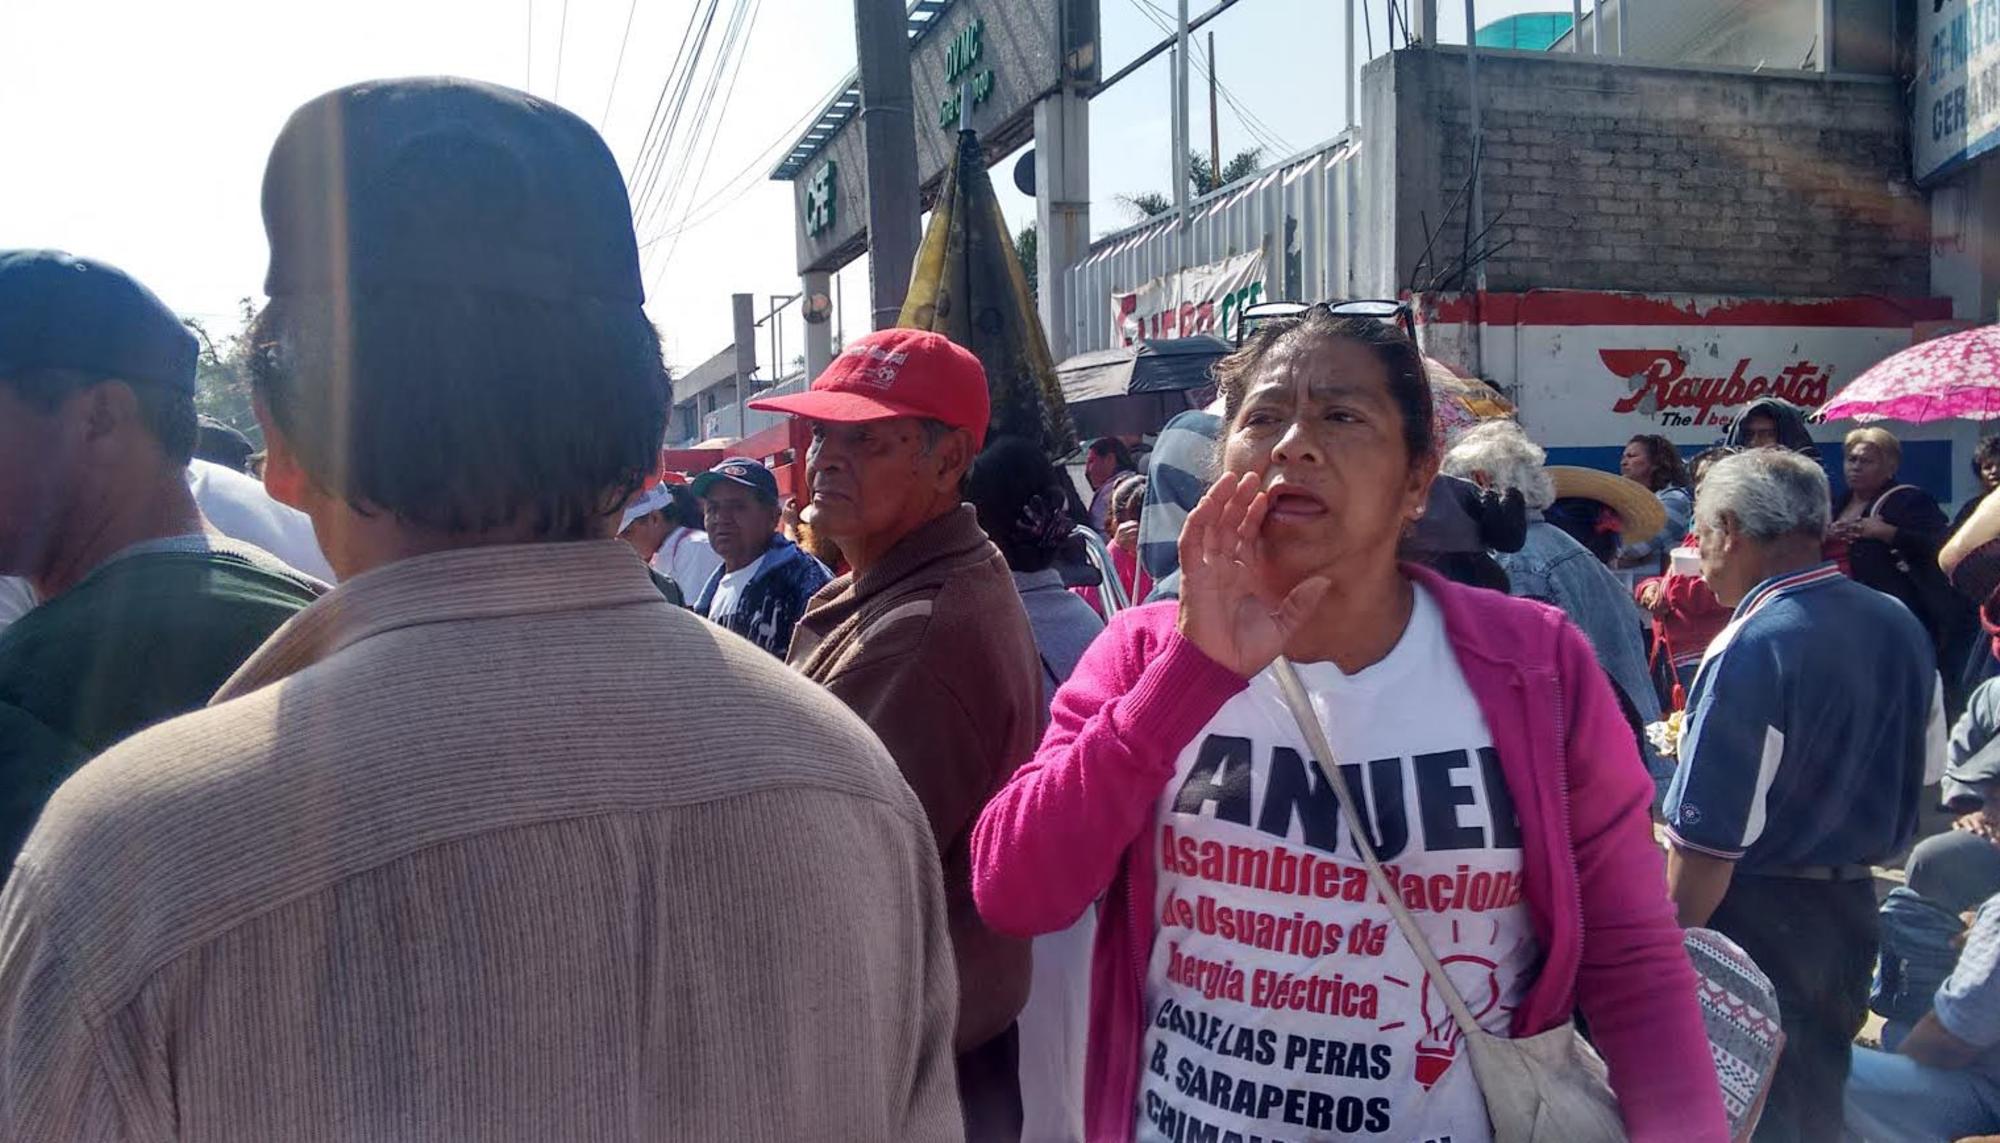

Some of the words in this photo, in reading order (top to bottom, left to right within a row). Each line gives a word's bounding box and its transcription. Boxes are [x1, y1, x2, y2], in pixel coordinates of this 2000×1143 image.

[804, 161, 834, 238] CFE
[1599, 348, 1830, 426] Raybestos
[1660, 411, 1692, 427] The
[1163, 825, 1368, 903] Asamblea
[1197, 895, 1344, 959] Usuarios
[1348, 918, 1389, 957] de
[1251, 967, 1380, 1021] Eléctrica
[1155, 998, 1222, 1051] CALLE
[1217, 1023, 1278, 1066] LAS
[1284, 1033, 1393, 1081] PERAS
[1150, 1039, 1170, 1082] B.
[1175, 1056, 1391, 1134] SARAPEROS
